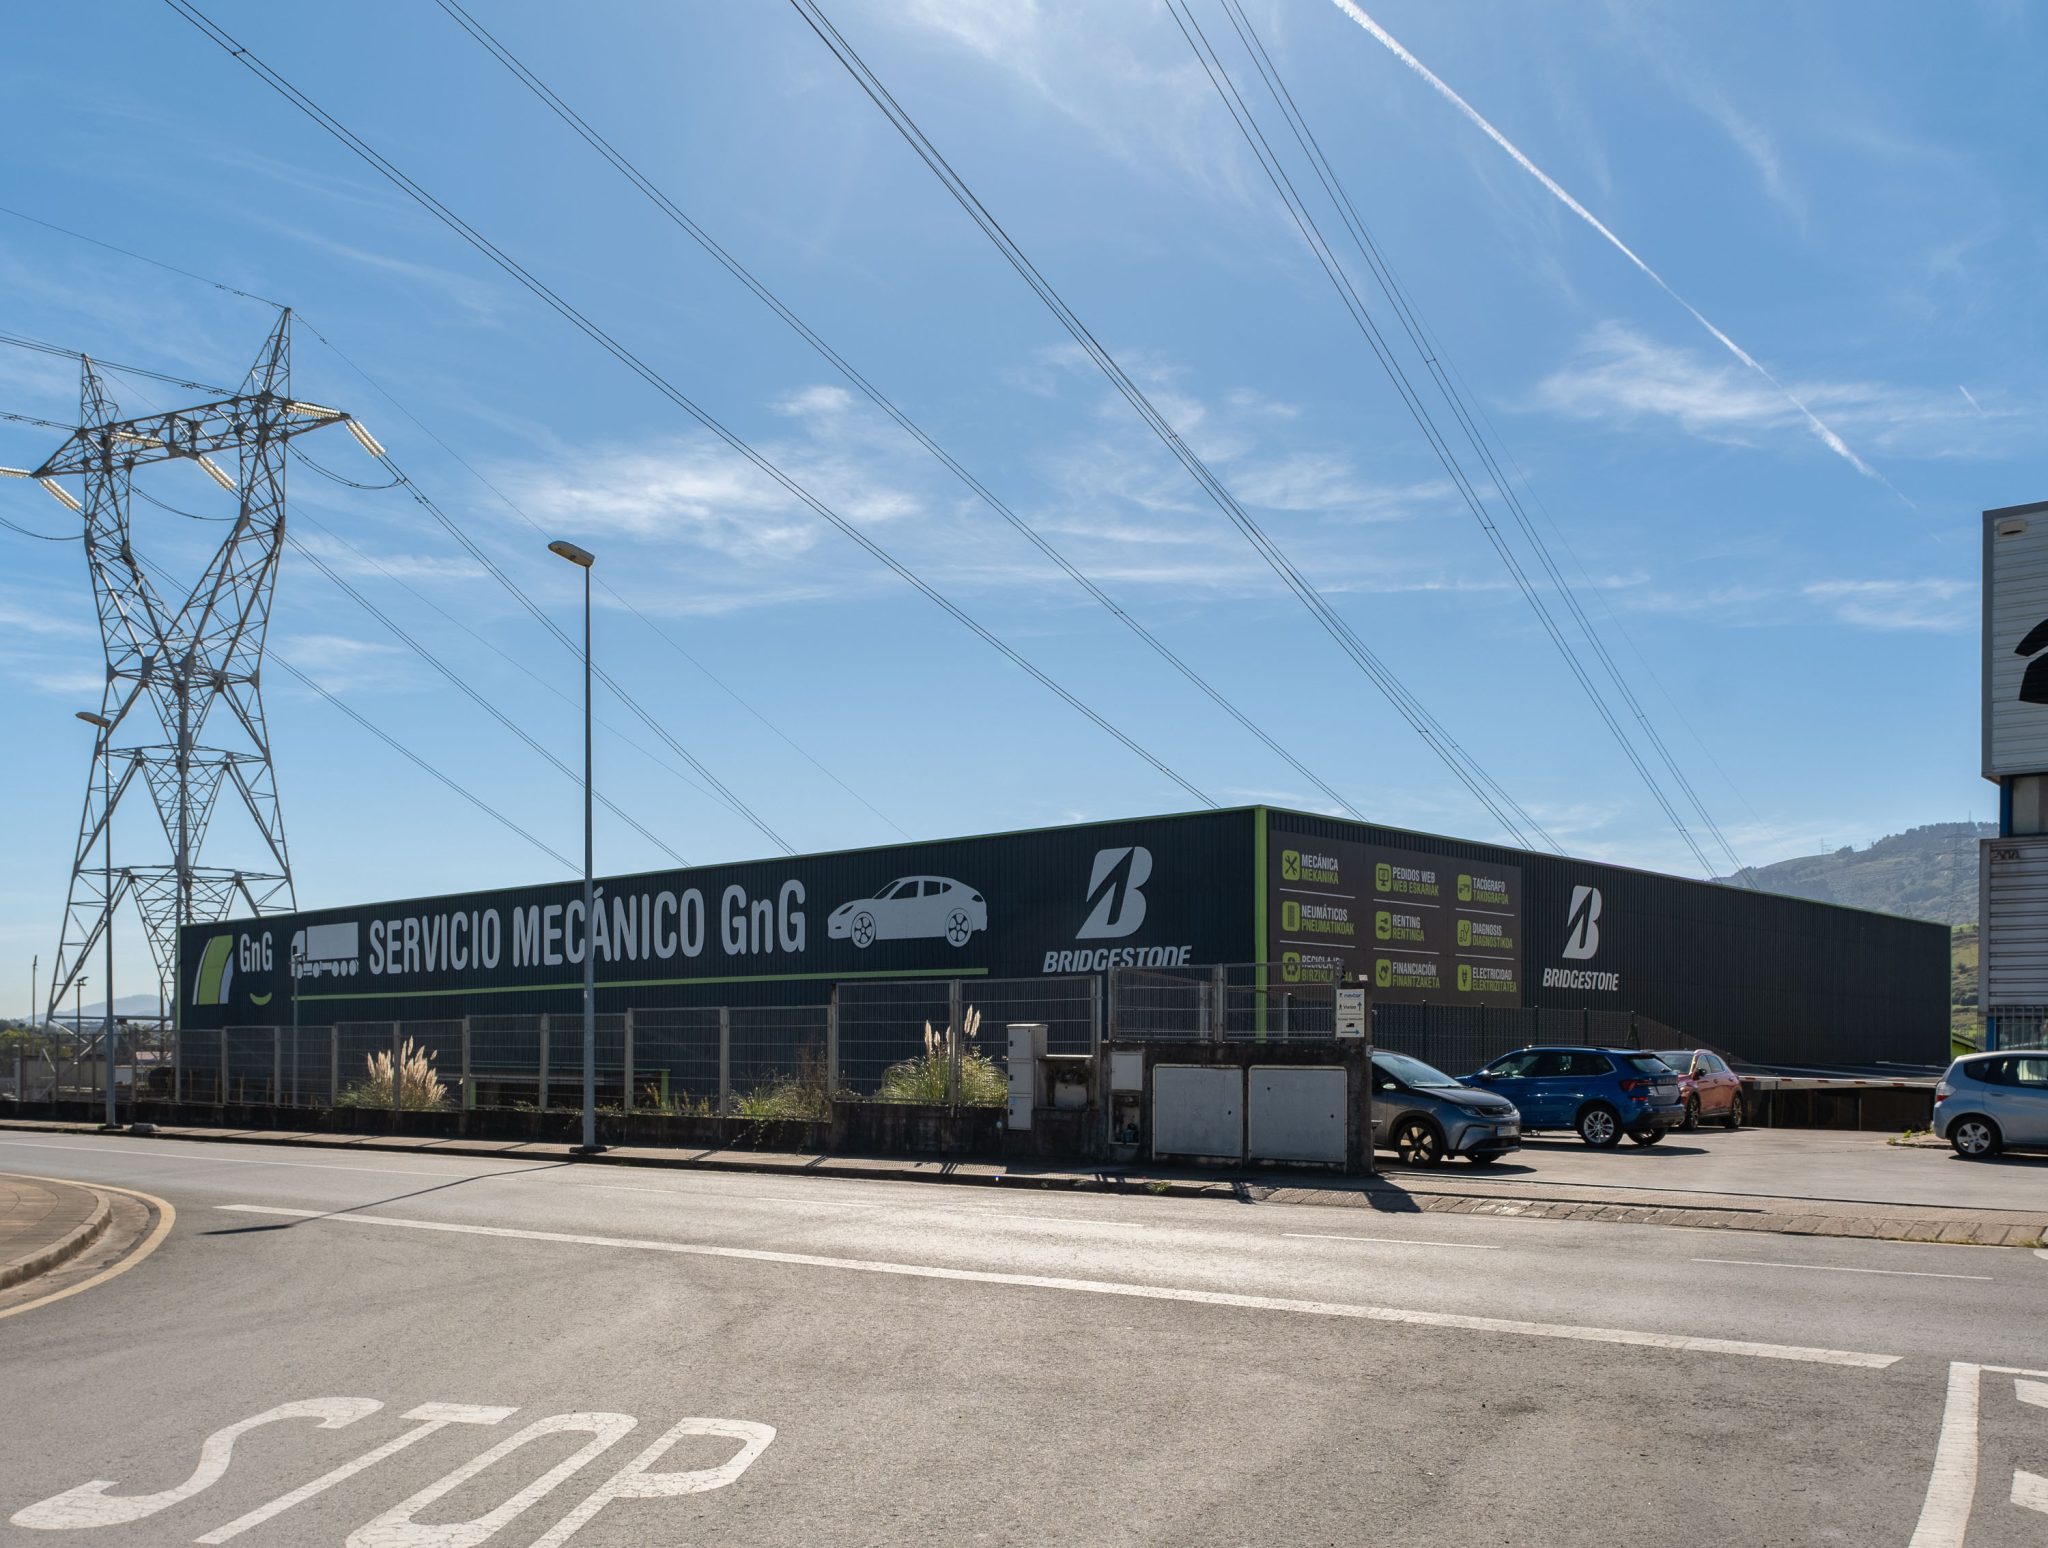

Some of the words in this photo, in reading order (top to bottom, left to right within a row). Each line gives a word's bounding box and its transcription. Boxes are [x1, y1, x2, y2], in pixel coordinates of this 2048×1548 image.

[1301, 853, 1339, 871] MECÁNICA
[1301, 868, 1339, 885] MEKANIKA
[1392, 867, 1420, 881] PEDIDOS
[1421, 870, 1436, 883] WEB
[1392, 879, 1408, 892] WEB
[1409, 882, 1439, 896] ESKARIAK
[1472, 876, 1505, 893] TACÓGRAFO
[1472, 889, 1509, 904] TAKOGRAFOA
[1301, 904, 1348, 921] NEUMÁTICOS
[369, 909, 500, 975] SERVICIO
[513, 886, 705, 967] MECÁNICO
[721, 879, 806, 956] GnG
[1301, 918, 1355, 936] PNEUMATIKOAK
[1392, 915, 1420, 929] RENTING
[1472, 922, 1502, 936] DIAGNOSIS
[1392, 928, 1424, 941] RENTINGA
[1472, 935, 1513, 949] DIAGNOSTIKOA
[240, 931, 272, 972] GnG
[1043, 945, 1193, 973] BRIDGESTONE
[1392, 961, 1437, 976] FINANCIACIÓN
[1472, 967, 1512, 981] ELECTRICIDAD
[1392, 974, 1440, 988] FINANTZAKETA
[1472, 980, 1517, 992] ELEKTRIZITATEA
[1543, 968, 1620, 992] BRIDGESTONE
[9, 1396, 778, 1548] STOP
